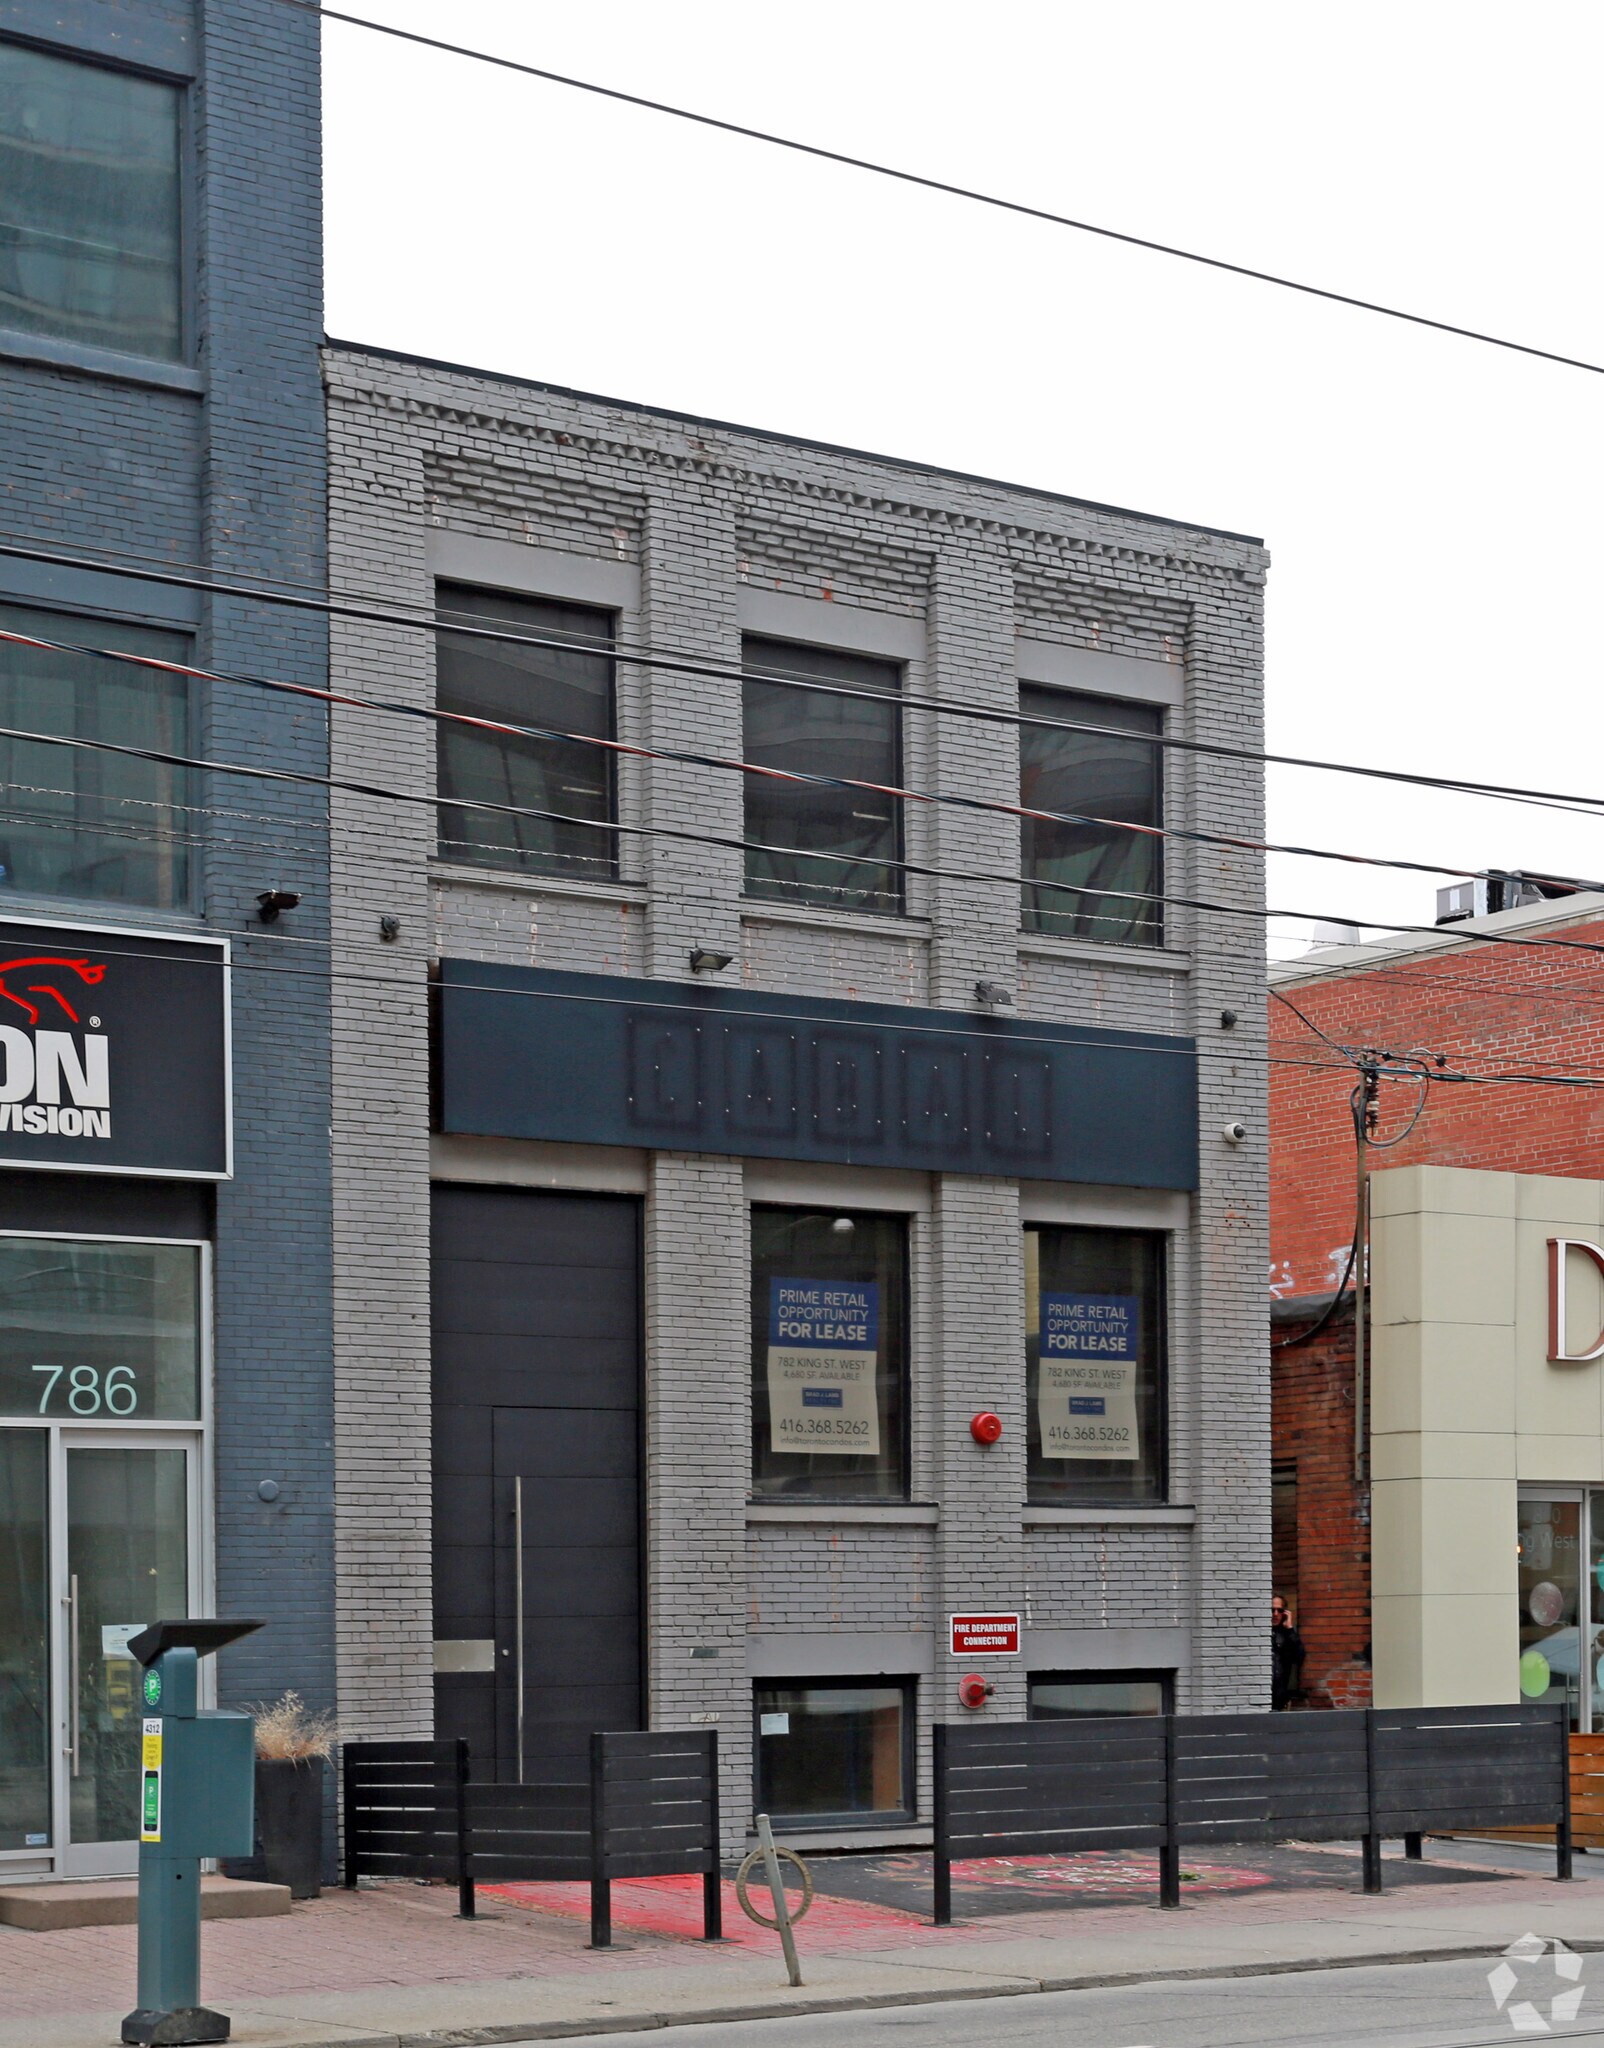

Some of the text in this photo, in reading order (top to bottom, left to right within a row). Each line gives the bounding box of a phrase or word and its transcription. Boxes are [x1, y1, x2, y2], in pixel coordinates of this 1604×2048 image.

[779, 1289, 869, 1308] PRIME RETAIL
[1546, 1238, 1604, 1361] D
[778, 1305, 869, 1322] OPPORTUNITY
[1048, 1303, 1129, 1320] PRIME RETAIL
[779, 1321, 867, 1341] FOR LEASE
[1047, 1318, 1129, 1334] OPPORTUNITY
[1047, 1334, 1127, 1352] FOR LEASE
[777, 1356, 867, 1371] 782 KING ST. WEST
[819, 1371, 860, 1382] AVAILABLE
[1047, 1367, 1063, 1378] 782
[1064, 1368, 1086, 1379] KING
[1102, 1370, 1128, 1380] WEST
[31, 1365, 138, 1415] 786
[1084, 1381, 1121, 1391] AVAILABLE
[779, 1419, 869, 1435] 416.368.5262
[1048, 1426, 1130, 1441] 416.368.5262
[1540, 1532, 1576, 1549] West
[954, 1624, 1016, 1633] FIRE DEPARTMENT
[963, 1636, 1008, 1645] CONNECTION
[145, 1723, 160, 1734] 4312
